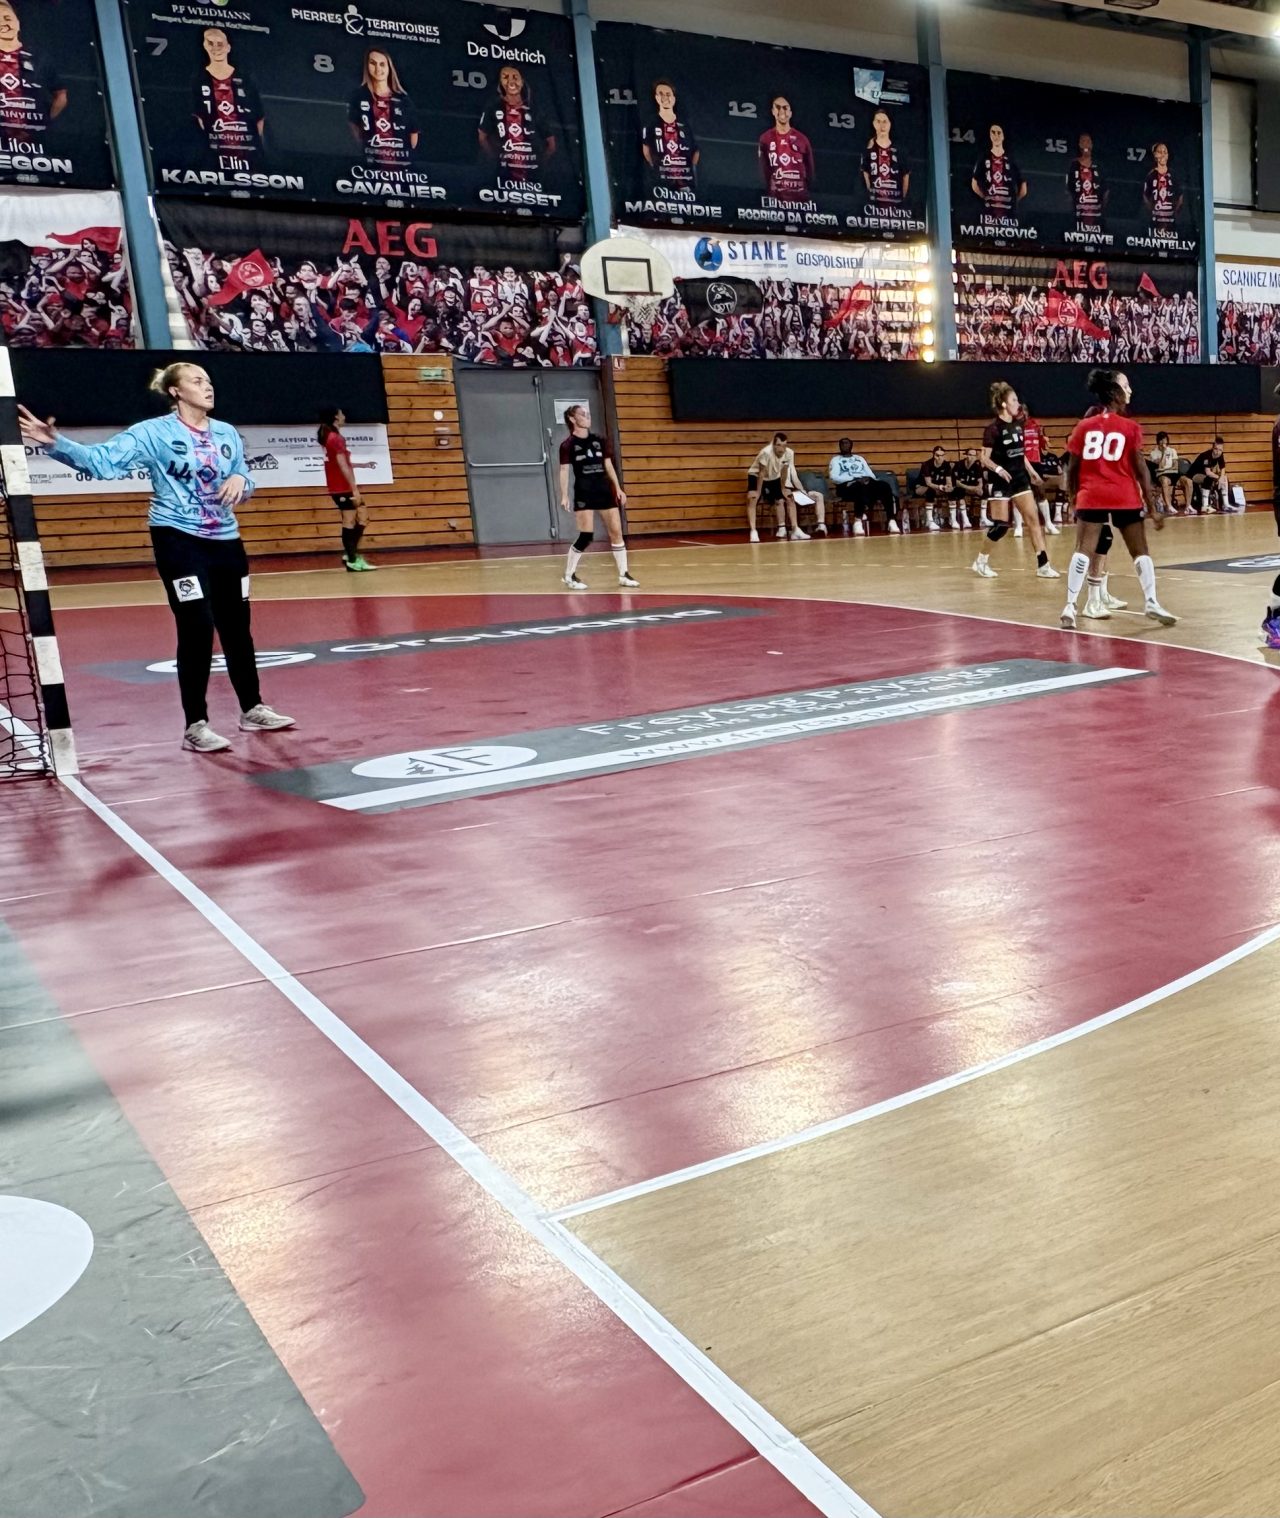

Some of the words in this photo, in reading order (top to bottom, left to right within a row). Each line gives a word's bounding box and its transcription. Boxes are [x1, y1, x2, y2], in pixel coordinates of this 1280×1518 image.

[187, 6, 251, 21] WEIDMANN
[291, 8, 343, 24] PIERRES
[365, 17, 440, 36] TERRITOIRES
[146, 36, 168, 56] 7
[467, 41, 488, 57] De
[491, 44, 546, 65] Dietrich
[313, 54, 335, 73] 8
[452, 70, 488, 89] 10
[607, 88, 637, 104] 11
[729, 101, 758, 119] 12
[828, 112, 856, 130] 13
[952, 128, 975, 144] 14
[1045, 138, 1068, 154] 15
[1126, 148, 1146, 161] 17
[162, 168, 304, 190] KARLSSON
[351, 165, 429, 186] Corentine
[497, 176, 542, 193] Louise
[336, 179, 447, 200] CAVALIER
[479, 189, 562, 208] CUSSET
[625, 201, 723, 219] MAGENDIE
[737, 207, 785, 223] RODRIGO
[787, 210, 803, 224] DA
[805, 212, 839, 227] COSTA
[846, 216, 926, 231] GUERRIER
[960, 223, 1038, 240] MARKOVIĆ
[342, 219, 438, 259] AEG
[1064, 231, 1114, 246] N'DIAYE
[1126, 236, 1196, 251] CHANTELLY
[1052, 260, 1109, 290] AEG
[1223, 269, 1267, 288] SCANNEZ
[1082, 430, 1126, 461] 80
[578, 696, 818, 735] Freytag
[804, 667, 1010, 700] Paysage
